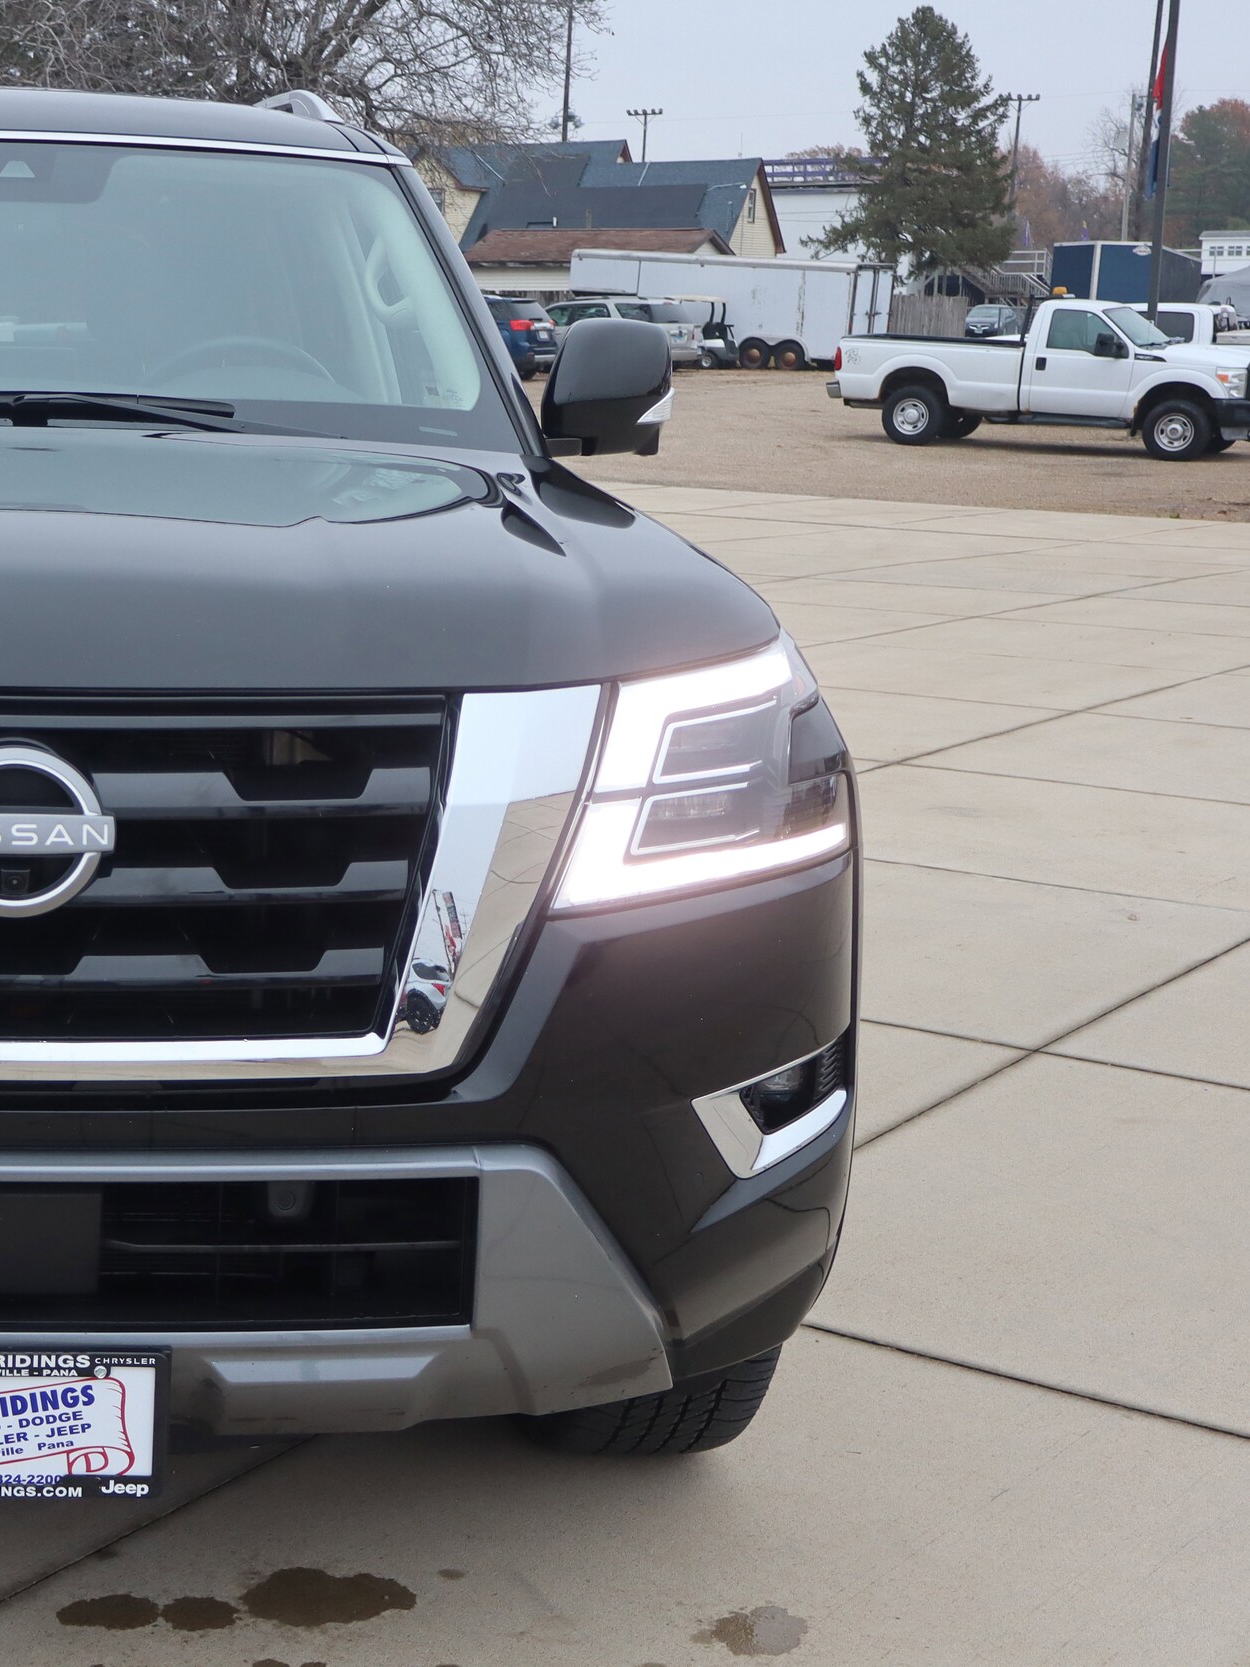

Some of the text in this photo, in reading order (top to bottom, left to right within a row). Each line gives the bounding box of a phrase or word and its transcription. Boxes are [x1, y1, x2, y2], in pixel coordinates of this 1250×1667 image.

[94, 1357, 156, 1365] CHRYSLER
[42, 1369, 78, 1377] PANA
[18, 1410, 84, 1429] DODGE
[45, 1423, 92, 1438] JEEP
[37, 1440, 74, 1451] Pana
[100, 1479, 149, 1497] Jeep
